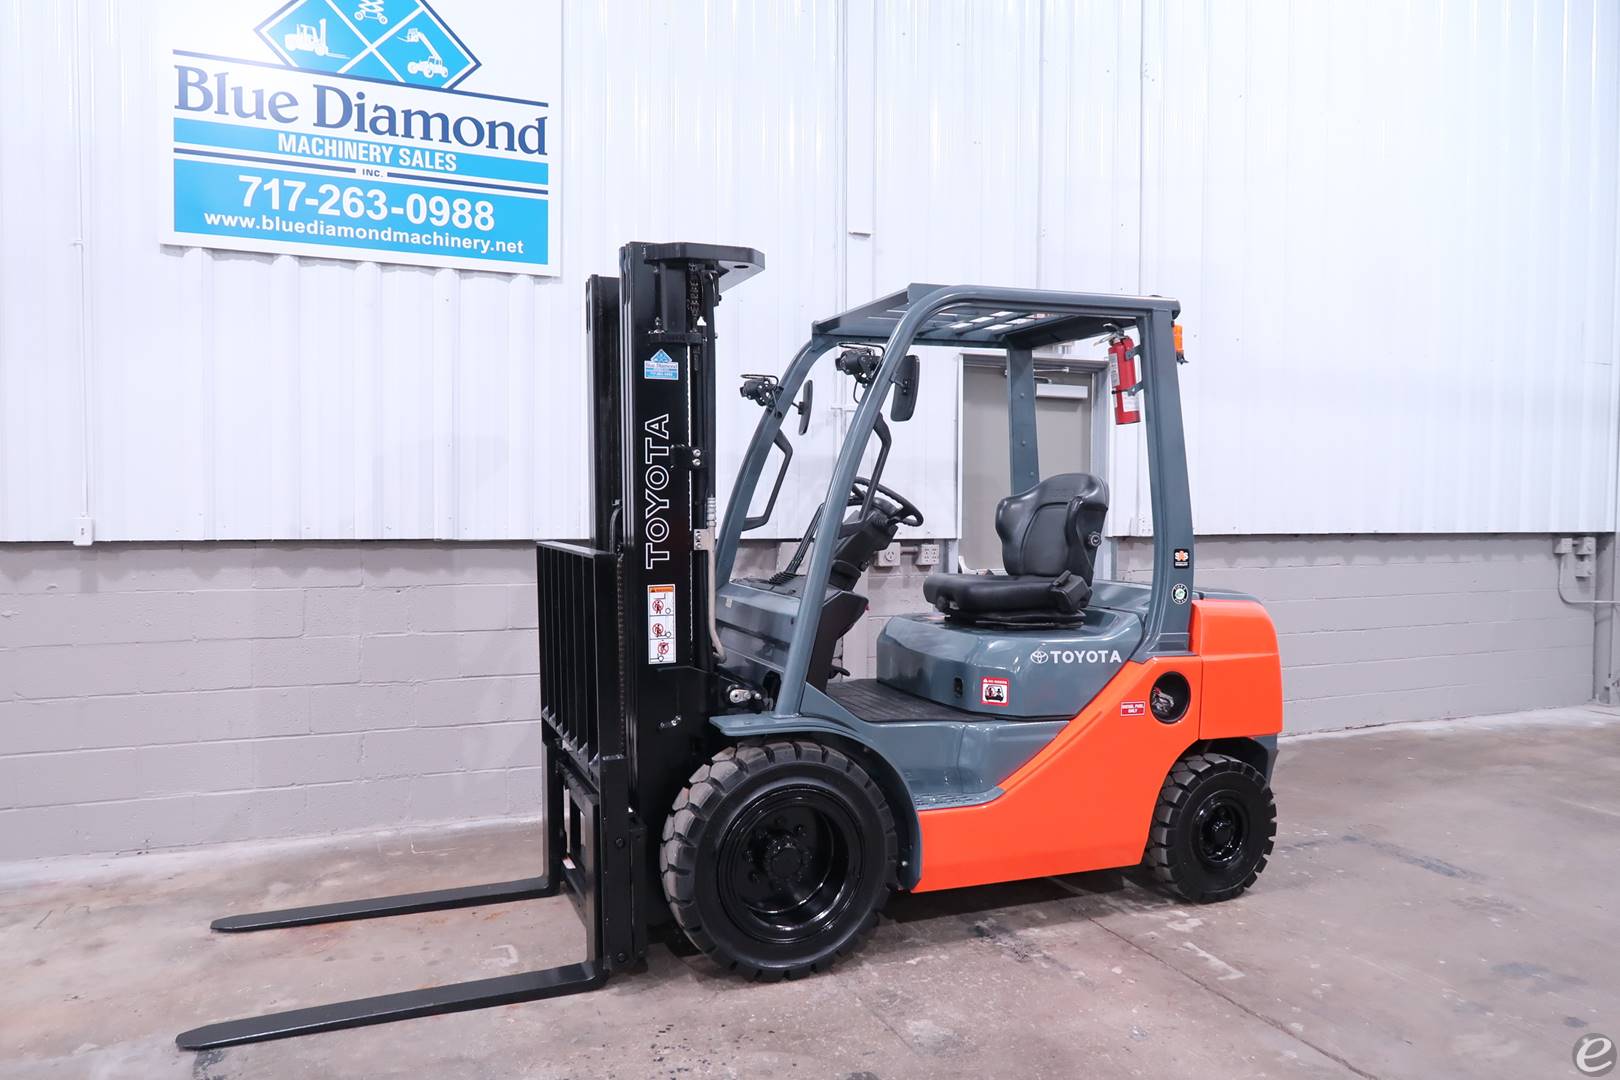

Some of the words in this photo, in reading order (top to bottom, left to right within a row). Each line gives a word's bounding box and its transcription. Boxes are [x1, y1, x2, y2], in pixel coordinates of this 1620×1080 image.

[174, 64, 300, 124] Blue
[312, 83, 549, 156] Diamond
[278, 132, 394, 165] MACHINERY
[398, 148, 457, 172] SALES
[362, 168, 384, 178] INC.
[238, 174, 495, 231] 717-263-0988
[204, 211, 524, 254] www.bluediamondmachinery.net
[645, 414, 670, 570] TOYOTA
[1049, 649, 1122, 664] TOYOTA
